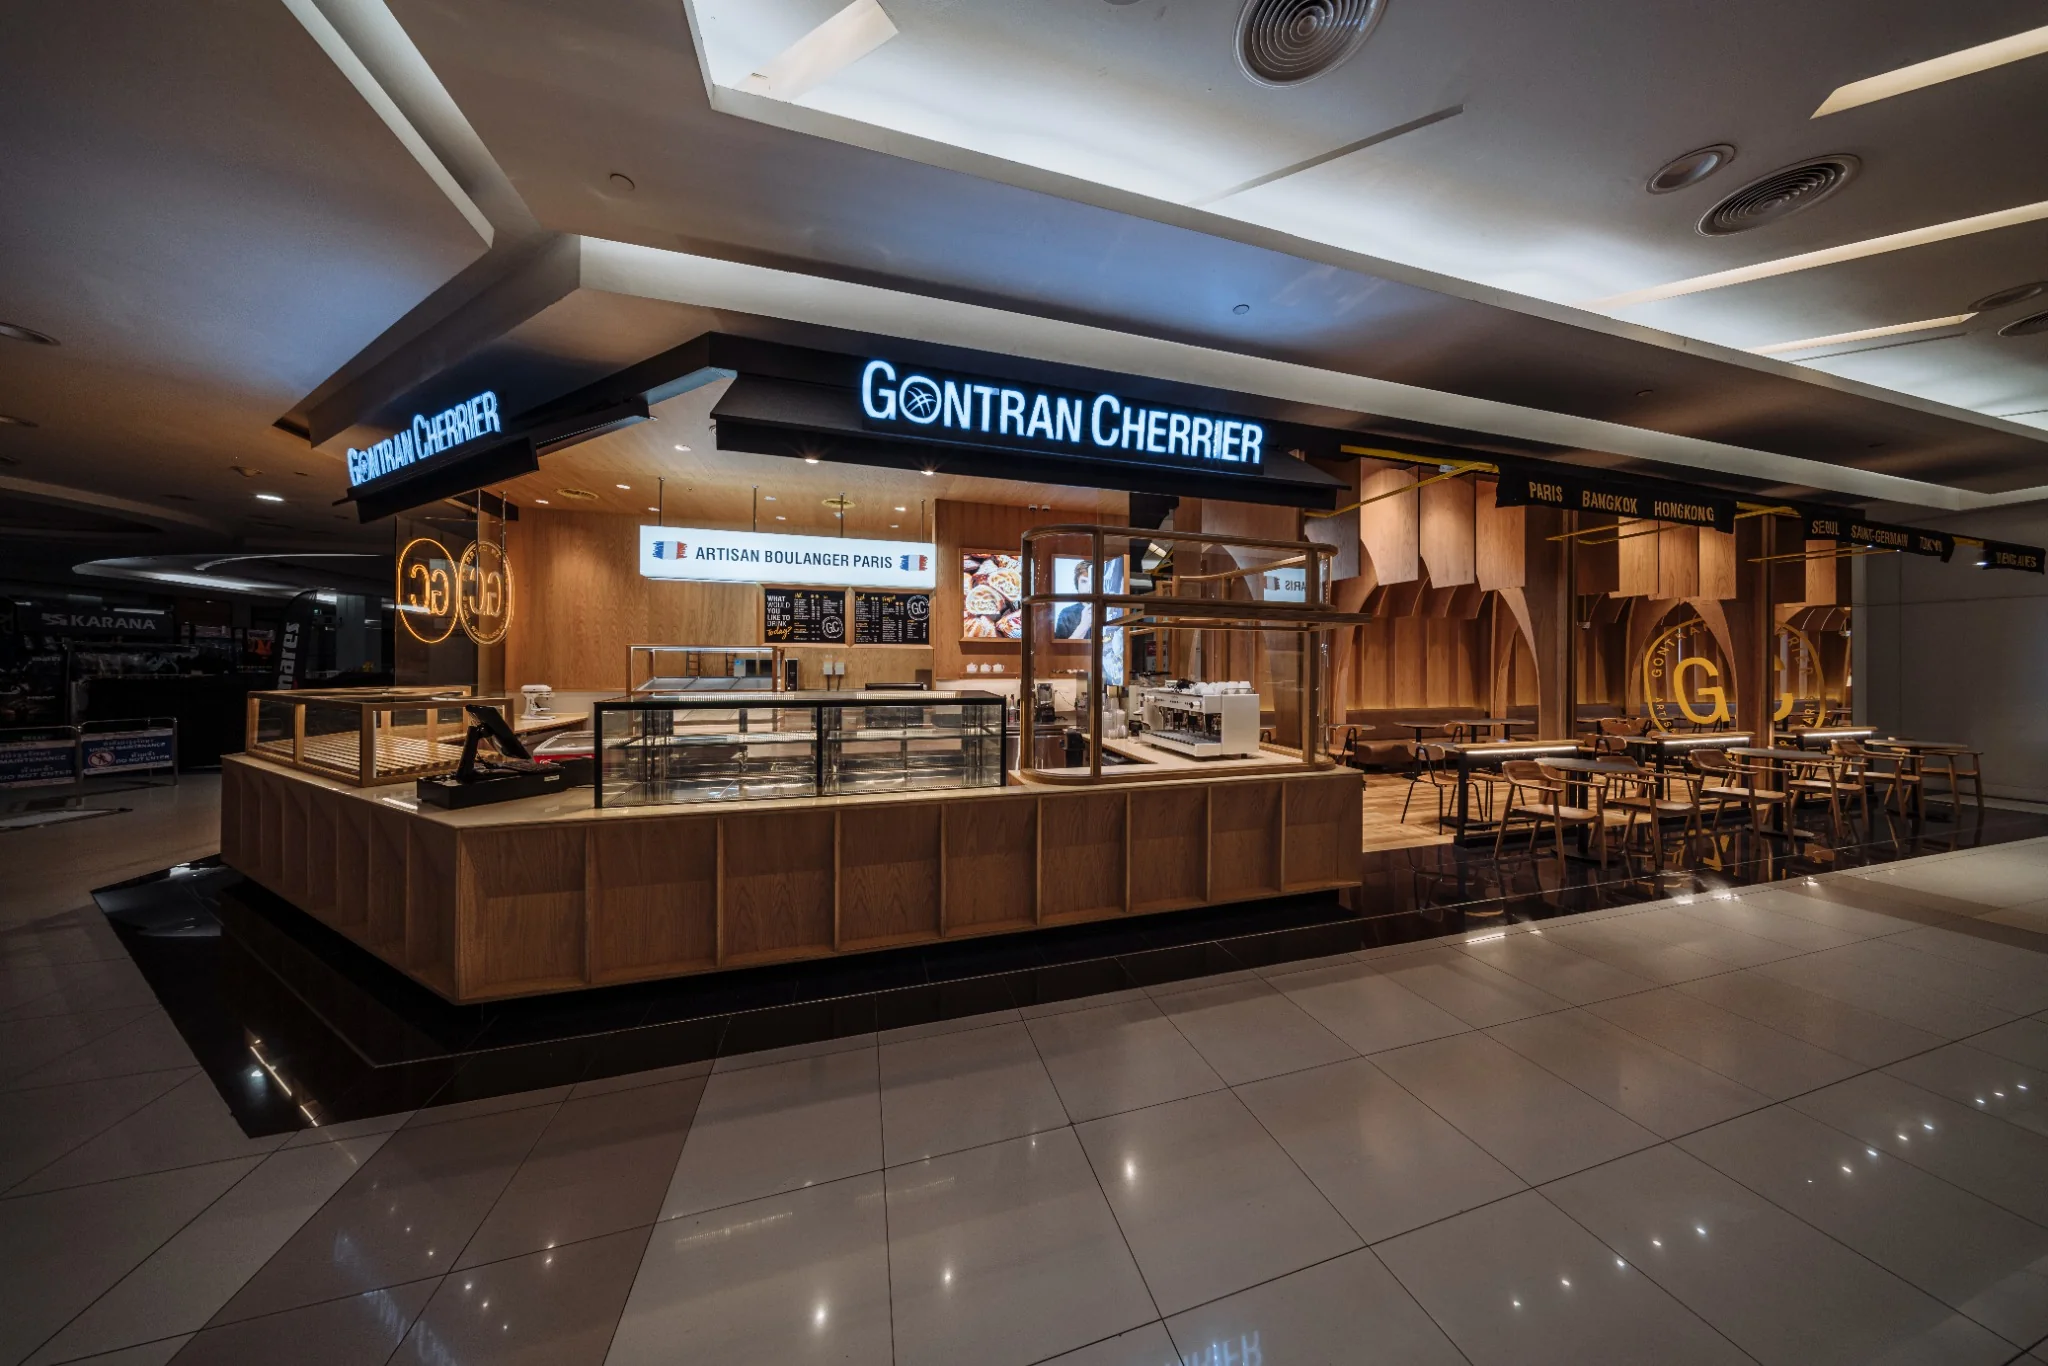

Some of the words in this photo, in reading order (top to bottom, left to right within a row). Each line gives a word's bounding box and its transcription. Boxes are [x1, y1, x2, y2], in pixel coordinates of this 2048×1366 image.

[347, 429, 416, 487] GONTRAN
[413, 390, 500, 460] CHERRIER
[861, 359, 1083, 443] GONTRAN
[1091, 394, 1264, 464] CHERRIER
[1528, 481, 1563, 502] PARIS
[1582, 490, 1638, 514] BANGKOK
[1654, 501, 1715, 522] HONGKONG
[695, 546, 760, 563] ARTISAN
[764, 550, 849, 567] BOULANGER
[853, 555, 893, 569] PARIS
[1811, 520, 1840, 536] SEOUL
[1851, 525, 1908, 547] SAINT-GERMAIN
[911, 601, 926, 615] GC
[277, 621, 301, 690] mares
[1673, 656, 1731, 725] G
